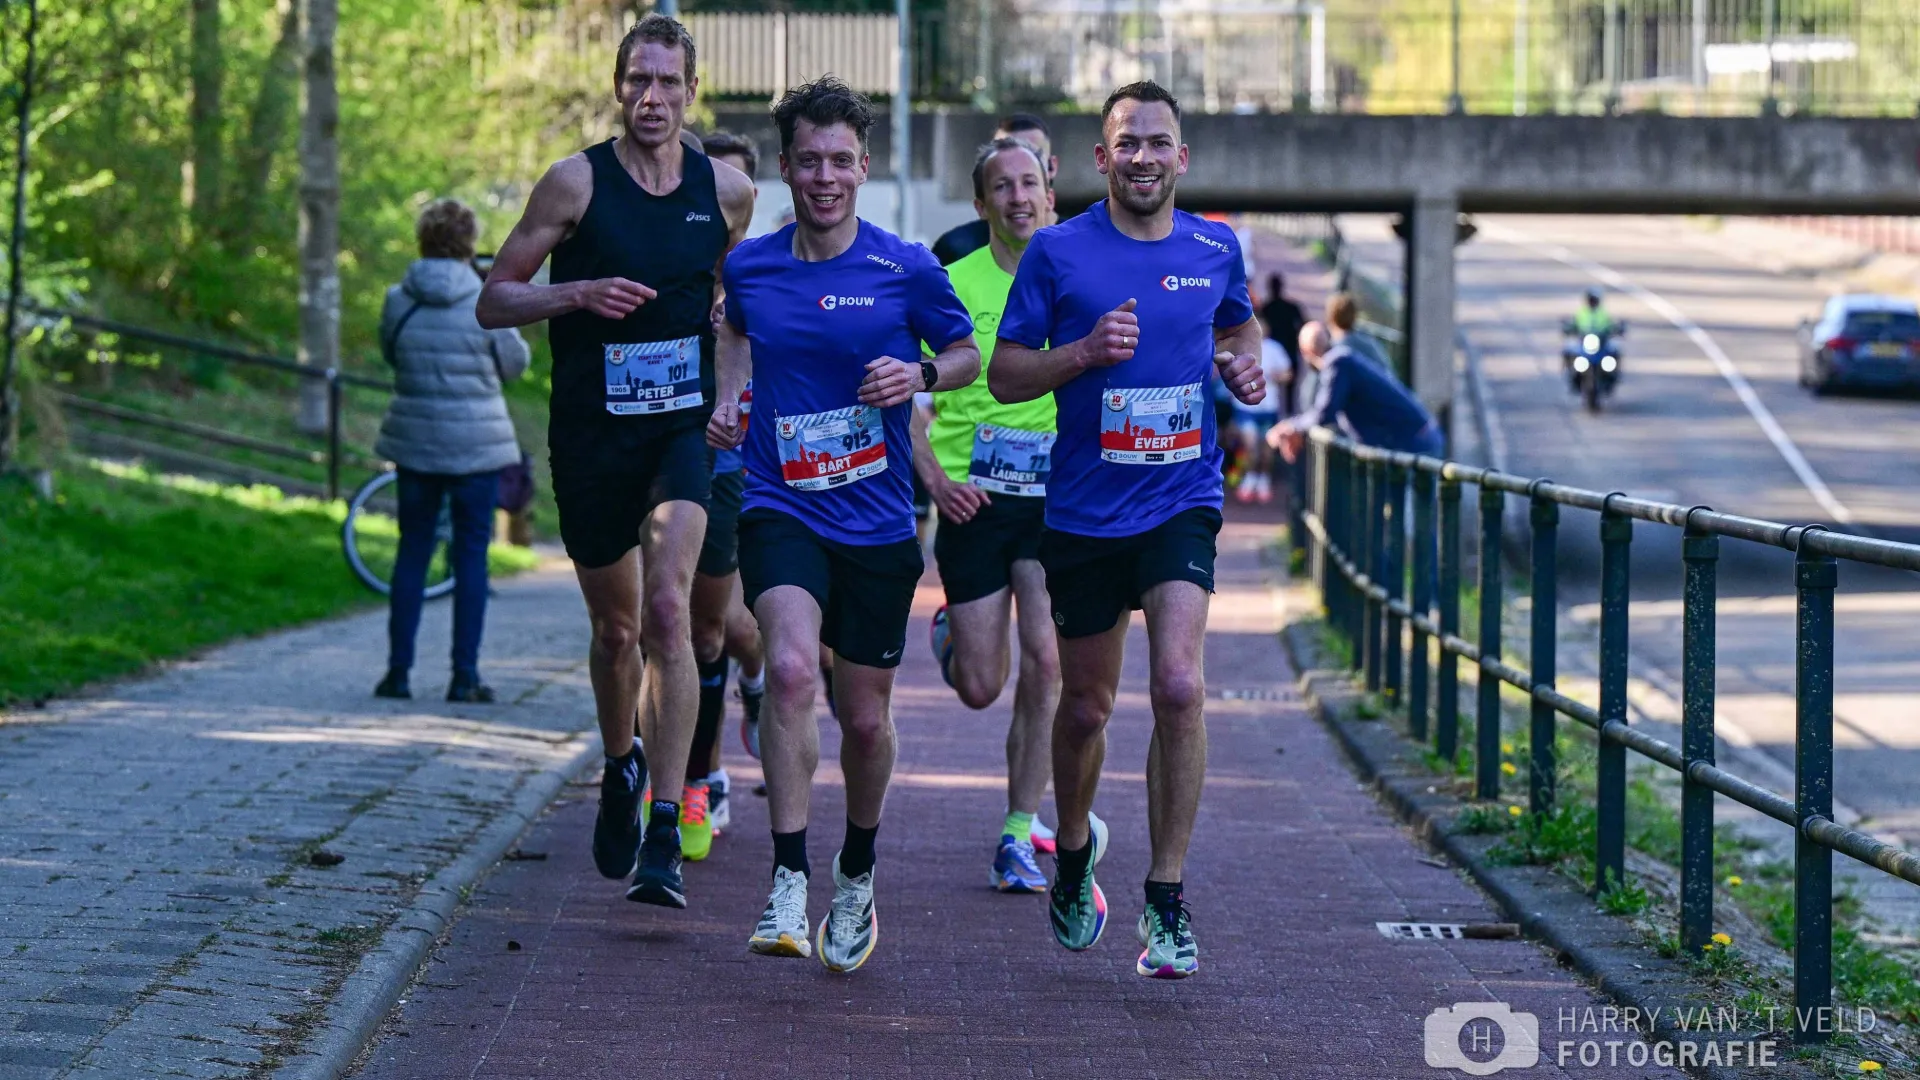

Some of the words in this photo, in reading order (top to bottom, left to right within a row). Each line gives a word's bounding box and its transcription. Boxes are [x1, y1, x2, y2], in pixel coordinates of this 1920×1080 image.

[1193, 232, 1223, 249] CRAFT
[866, 254, 897, 269] CRAFT
[1180, 277, 1211, 288] BOUW
[838, 296, 875, 307] BOUW
[667, 363, 688, 383] 101
[611, 386, 627, 394] 1905
[637, 385, 675, 400] PETER
[1168, 411, 1193, 432] 914
[842, 429, 872, 451] 915
[1134, 435, 1177, 449] EVERT
[817, 456, 852, 475] BART
[1029, 454, 1047, 469] 77
[990, 467, 1037, 483] LAURENS
